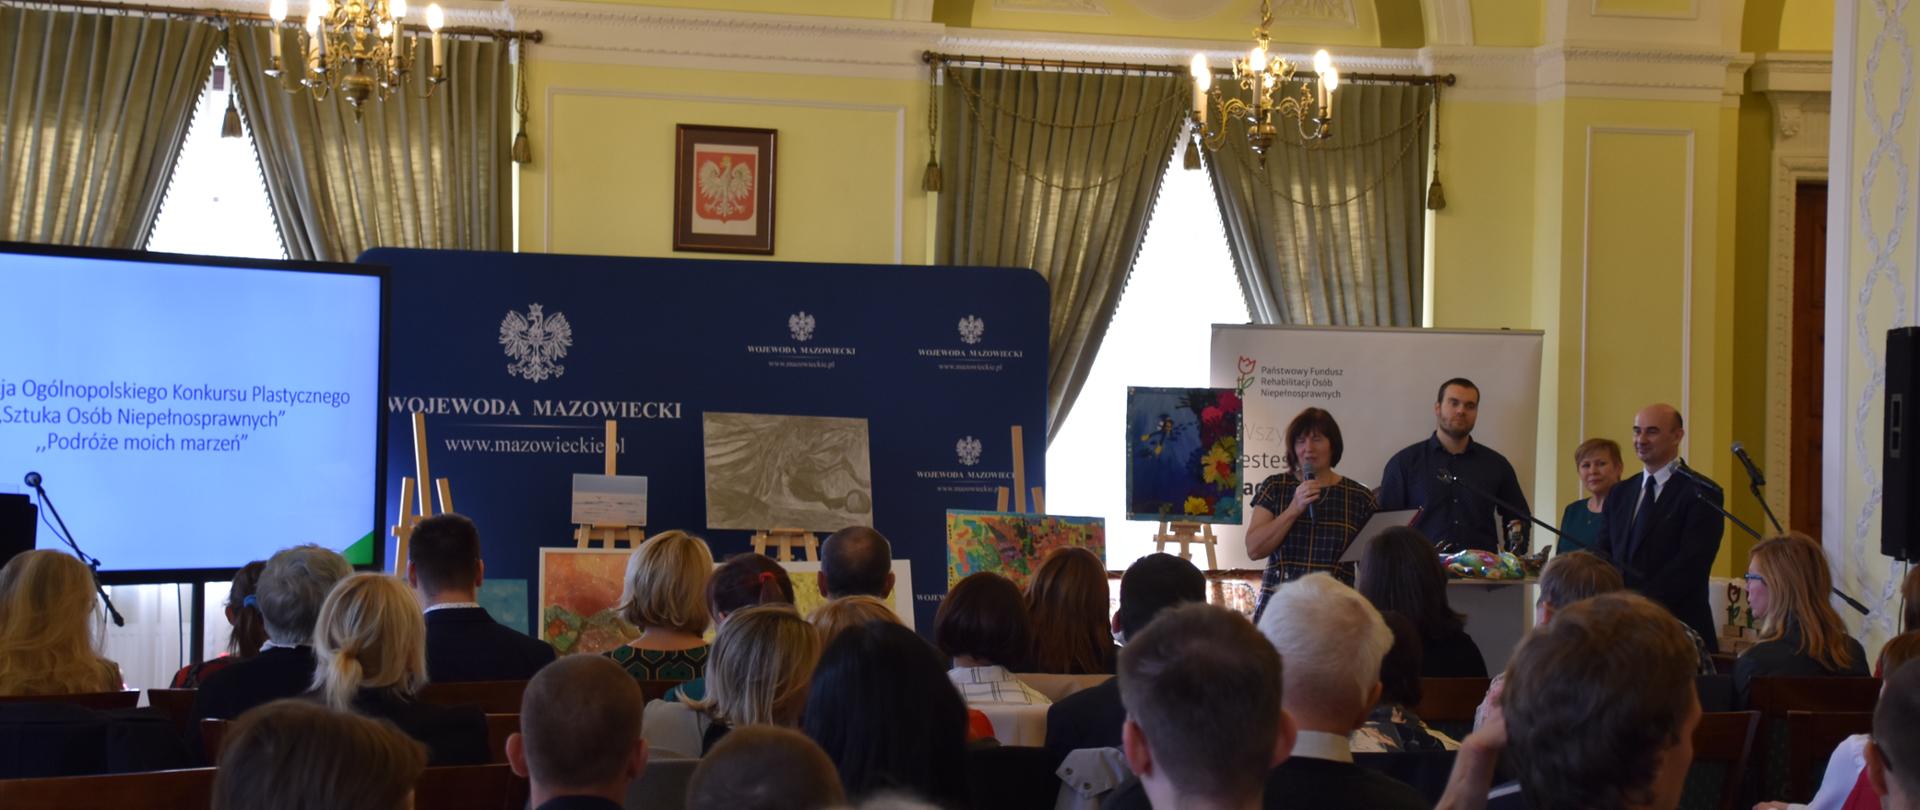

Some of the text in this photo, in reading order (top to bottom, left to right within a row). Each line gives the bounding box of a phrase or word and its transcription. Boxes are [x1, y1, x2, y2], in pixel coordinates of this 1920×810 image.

[747, 345, 856, 355] WOJEWODA MAZOWIECKI
[918, 349, 1023, 359] WOJEWODA MAZOWIECKI
[1261, 366, 1343, 377] Państwowy Fundusz
[1260, 377, 1333, 388] Rehabilitacji Osób
[22, 379, 168, 403] Ogólnopolskiego
[173, 383, 247, 402] Konkursu
[252, 385, 350, 408] Plastycznego
[1260, 389, 1341, 400] Niepełnosprawnych
[388, 396, 682, 419] WOJEWODA MAZOWIECKI
[67, 406, 112, 425] Osób
[124, 433, 175, 450] moich
[445, 436, 625, 454] www.mazowieckiepl
[916, 471, 963, 479] WOJEWODA
